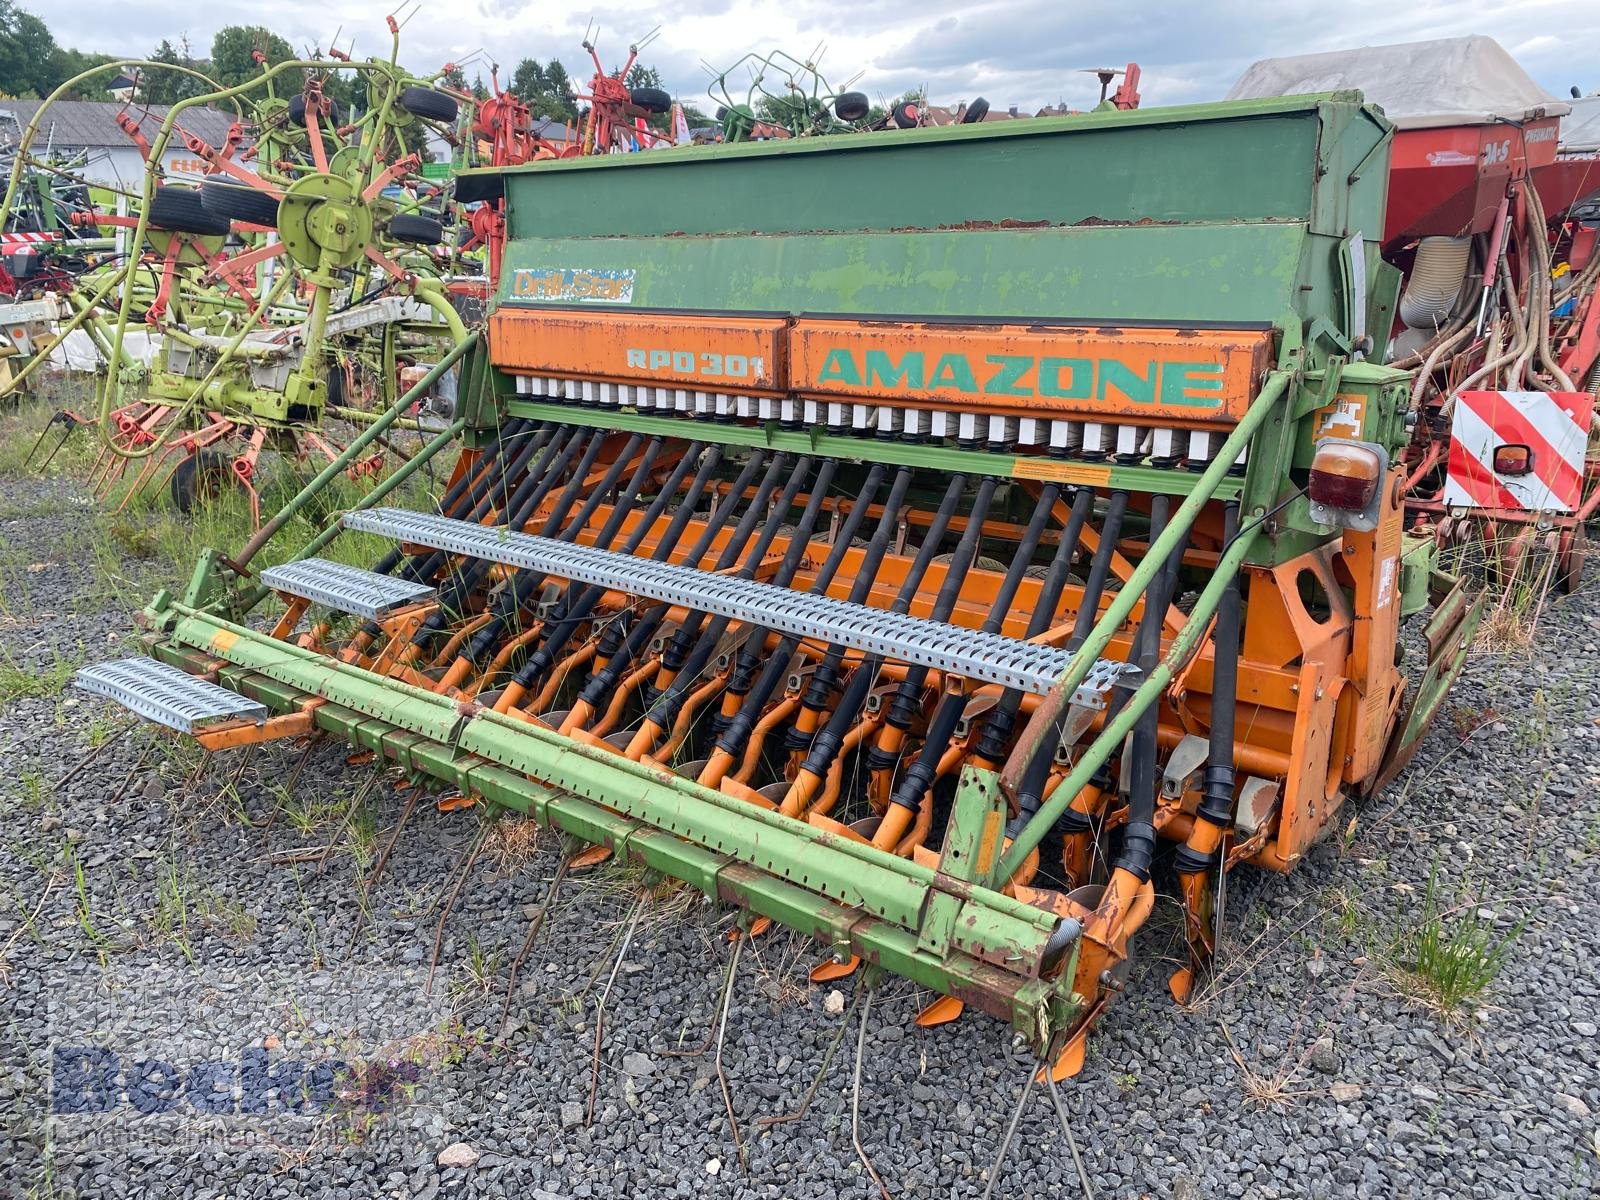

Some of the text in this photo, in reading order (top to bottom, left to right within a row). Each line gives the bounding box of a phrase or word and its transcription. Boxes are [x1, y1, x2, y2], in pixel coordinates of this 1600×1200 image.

[626, 348, 765, 380] RPD 301
[818, 349, 1224, 408] AMAZONE
